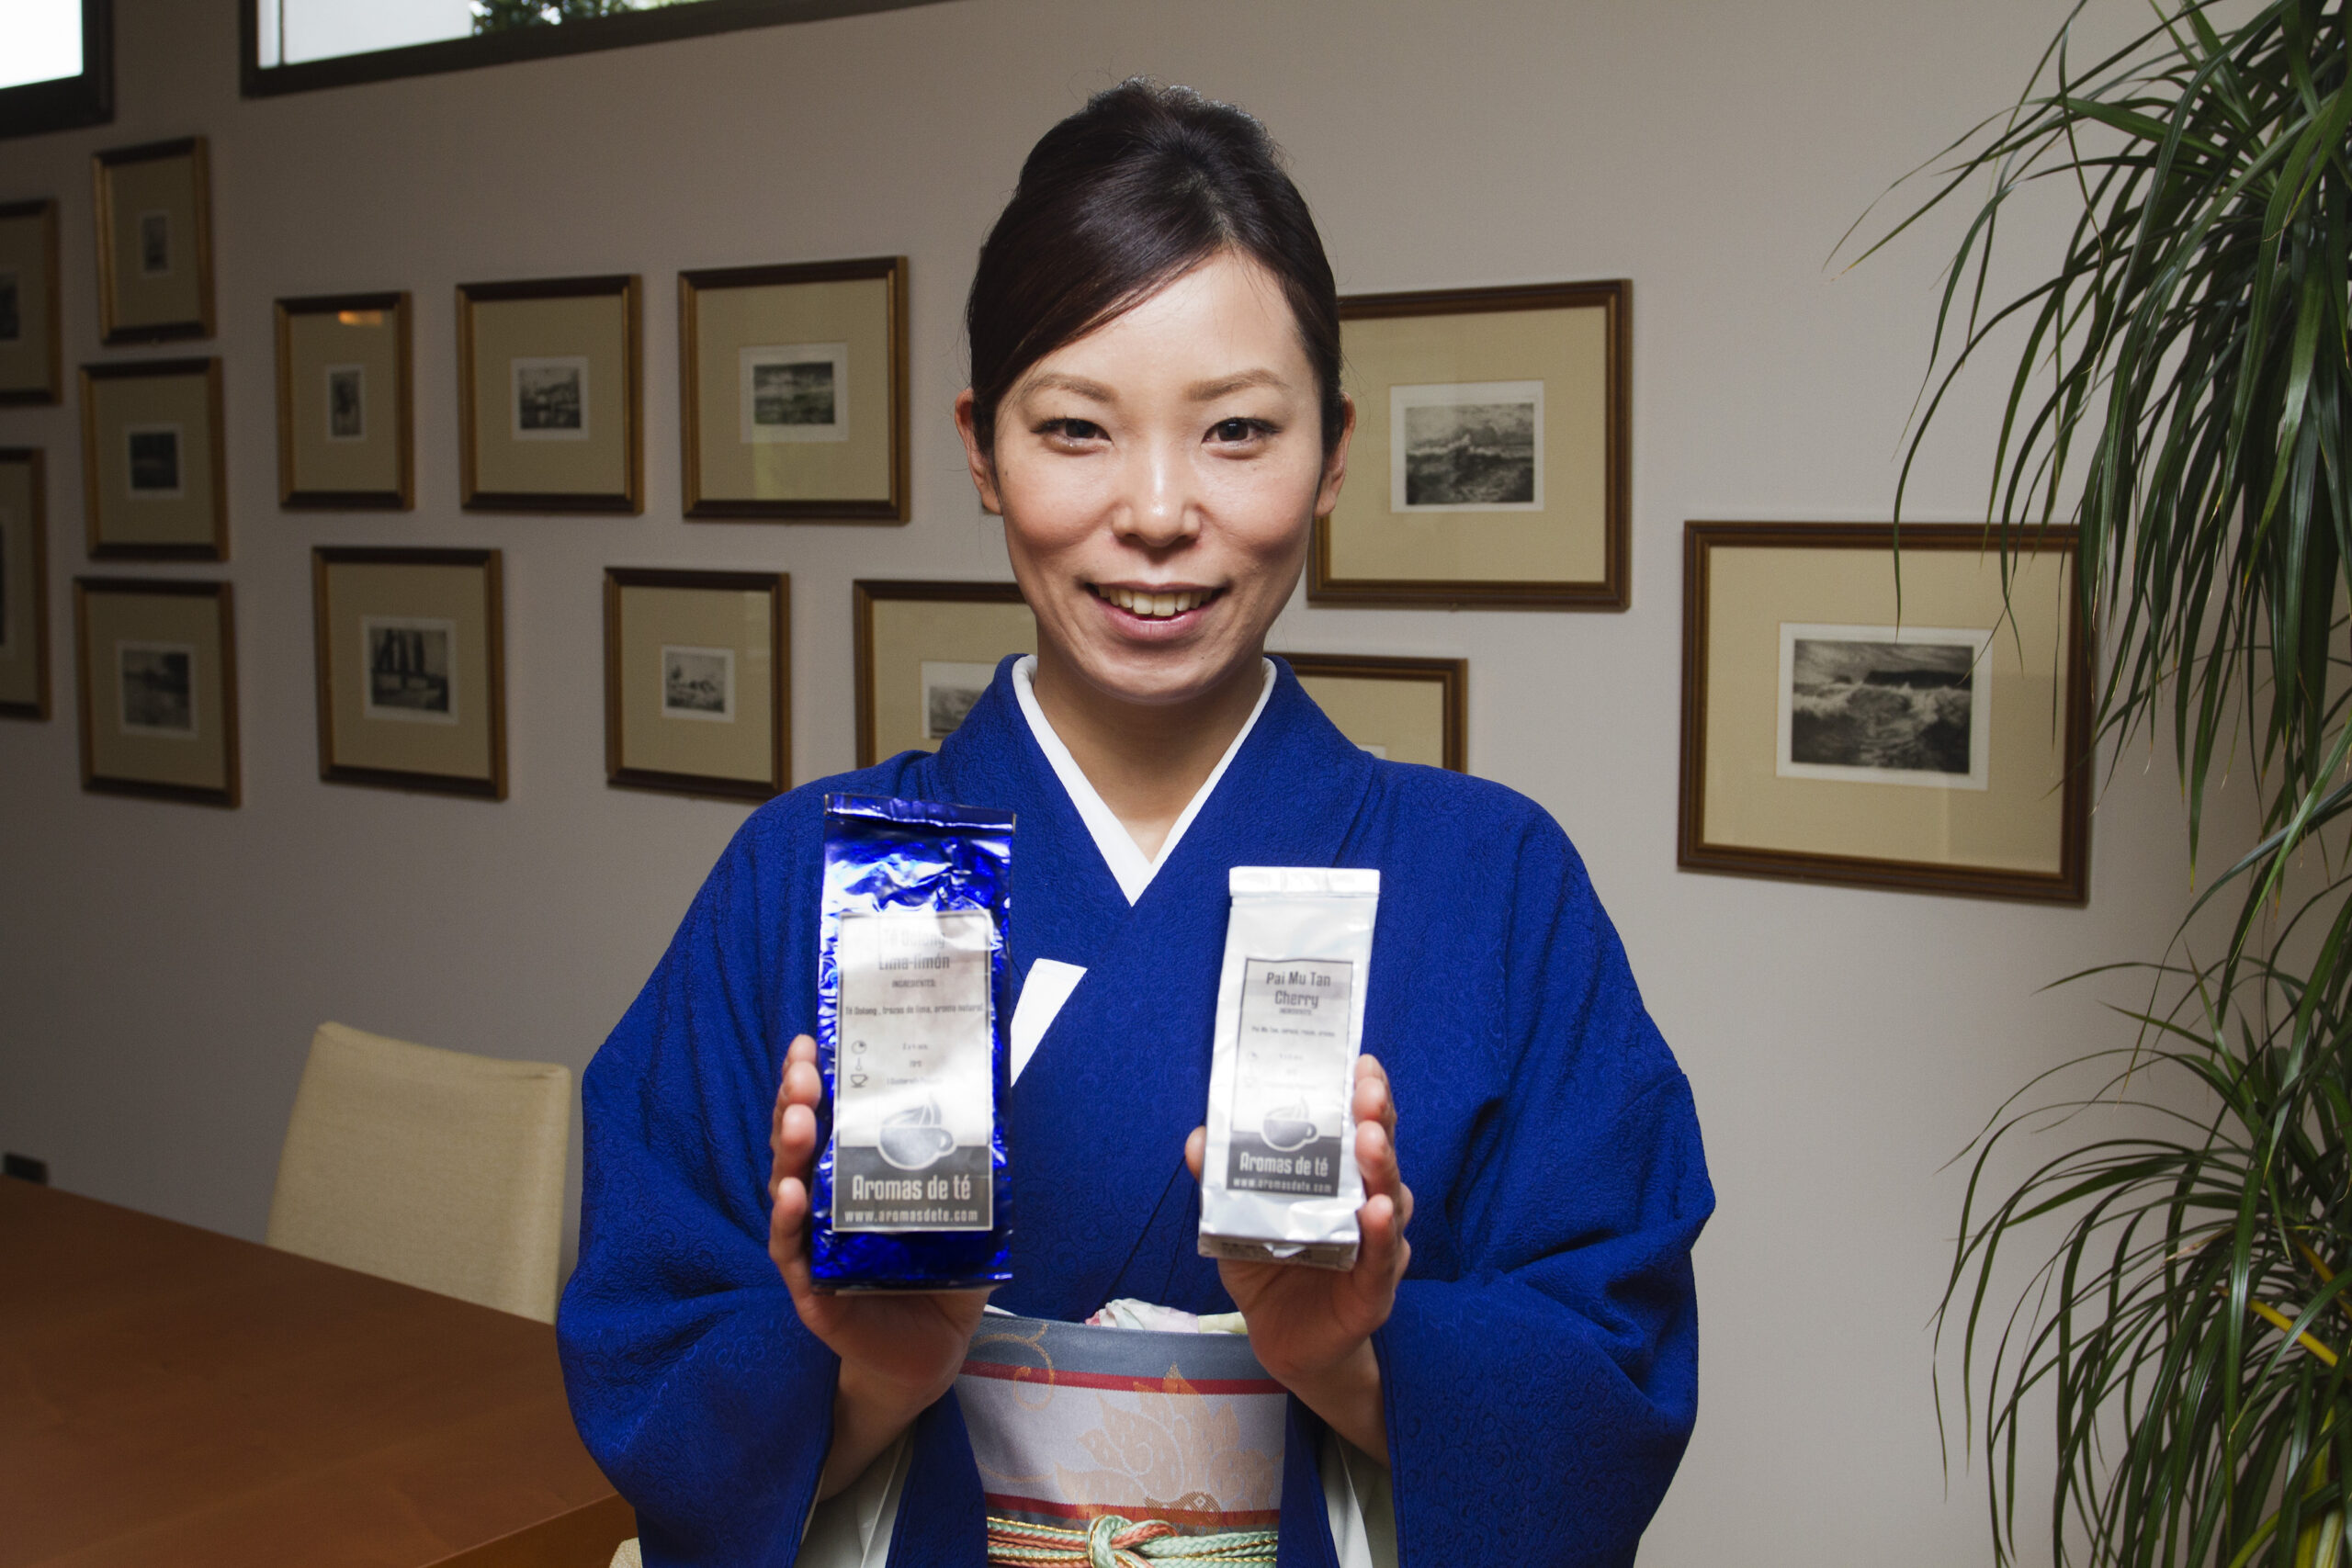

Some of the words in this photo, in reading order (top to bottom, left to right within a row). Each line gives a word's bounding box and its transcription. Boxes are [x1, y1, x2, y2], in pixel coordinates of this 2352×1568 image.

[1266, 971, 1285, 986] Pai
[1288, 970, 1306, 986] Mu
[1310, 971, 1331, 987] Tan
[1274, 989, 1319, 1010] Cherry
[1239, 1152, 1293, 1174] Aromas
[1295, 1156, 1312, 1177] de
[1315, 1156, 1329, 1178] té
[852, 1174, 922, 1201] Aromas
[927, 1174, 949, 1201] de
[953, 1174, 971, 1201] té
[1233, 1178, 1331, 1193] www.aromasdete.com
[844, 1208, 978, 1223] www.aromasdete.com
